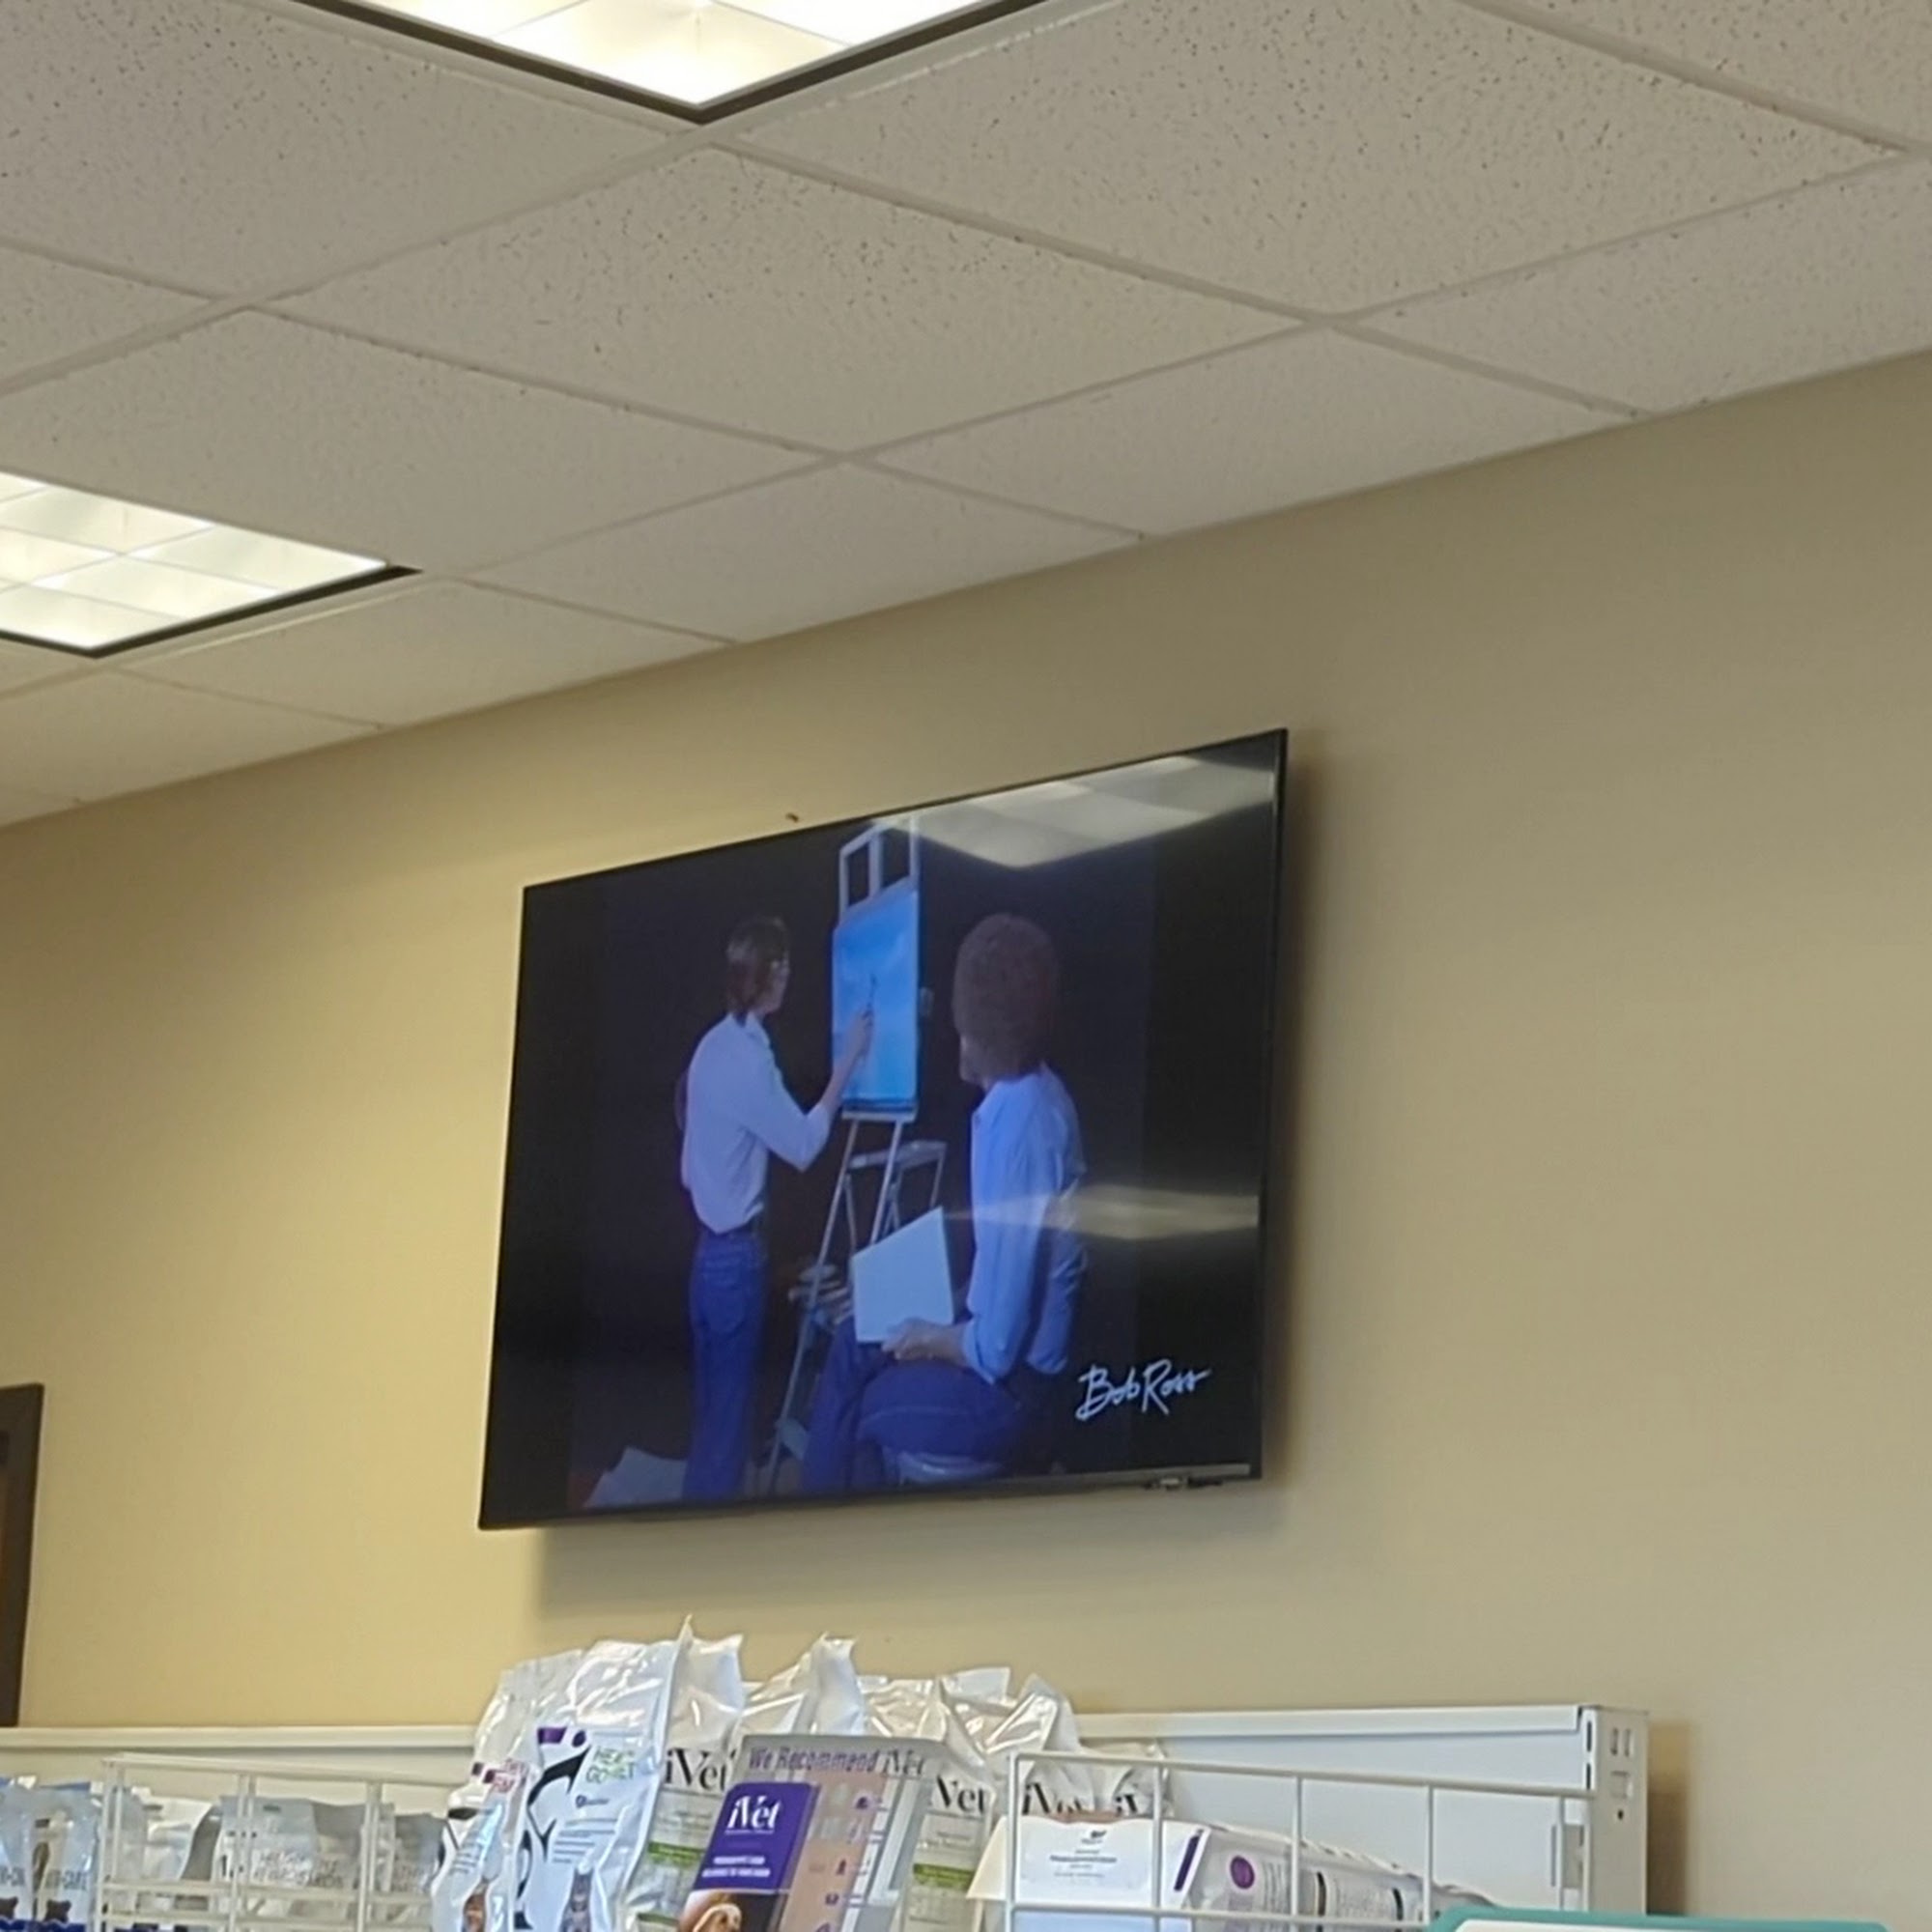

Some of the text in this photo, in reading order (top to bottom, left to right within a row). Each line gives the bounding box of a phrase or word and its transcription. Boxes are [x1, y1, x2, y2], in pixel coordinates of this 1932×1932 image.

[1075, 1358, 1213, 1422] Bob Ross
[664, 1747, 729, 1792] iVet
[749, 1746, 925, 1776] We Recommend iVet
[726, 1795, 781, 1830] iVet
[930, 1775, 985, 1815] Vet
